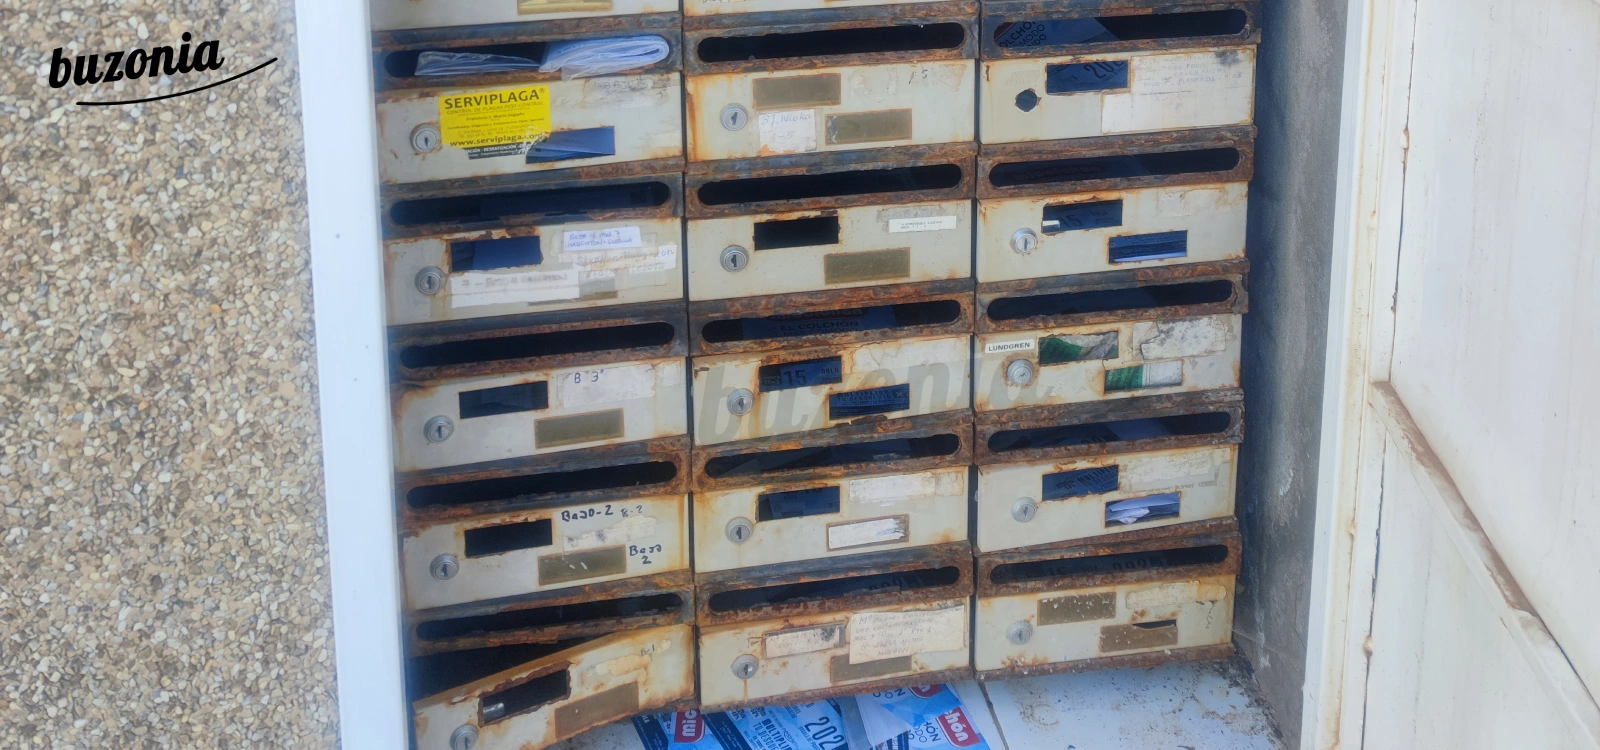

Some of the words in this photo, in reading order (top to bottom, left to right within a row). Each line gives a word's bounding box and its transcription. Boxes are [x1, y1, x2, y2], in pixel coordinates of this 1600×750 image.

[447, 106, 472, 115] CONTROL
[482, 104, 503, 112] PLAGAS
[988, 342, 1031, 352] LUNDGREN
[783, 369, 808, 387] 15
